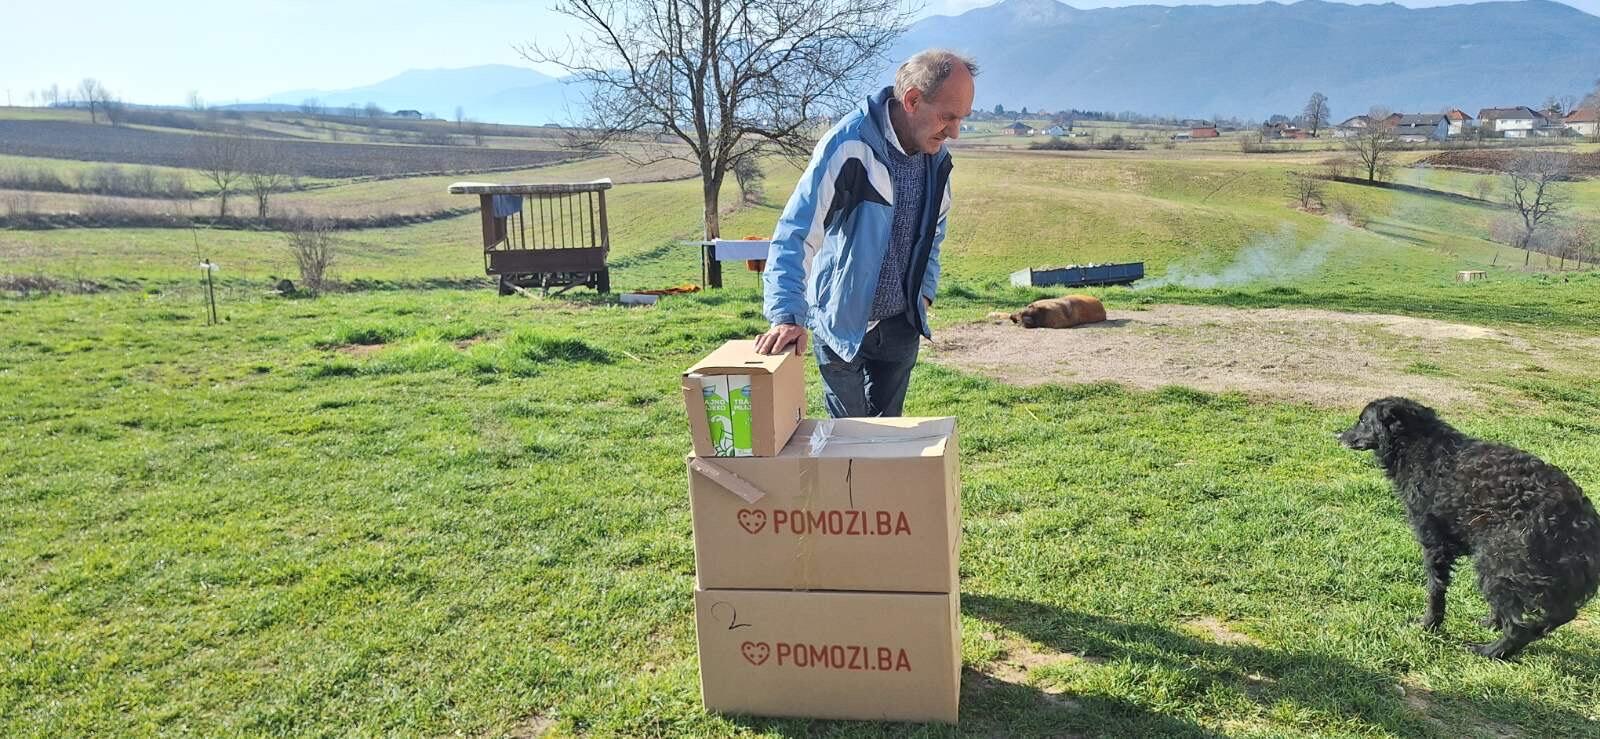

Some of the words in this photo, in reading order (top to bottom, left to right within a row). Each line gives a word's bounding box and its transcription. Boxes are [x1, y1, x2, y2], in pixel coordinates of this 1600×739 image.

[845, 458, 854, 509] 1
[773, 510, 912, 536] POMOZI.BA
[710, 601, 752, 630] 2
[776, 642, 912, 672] POMOZI.BA
